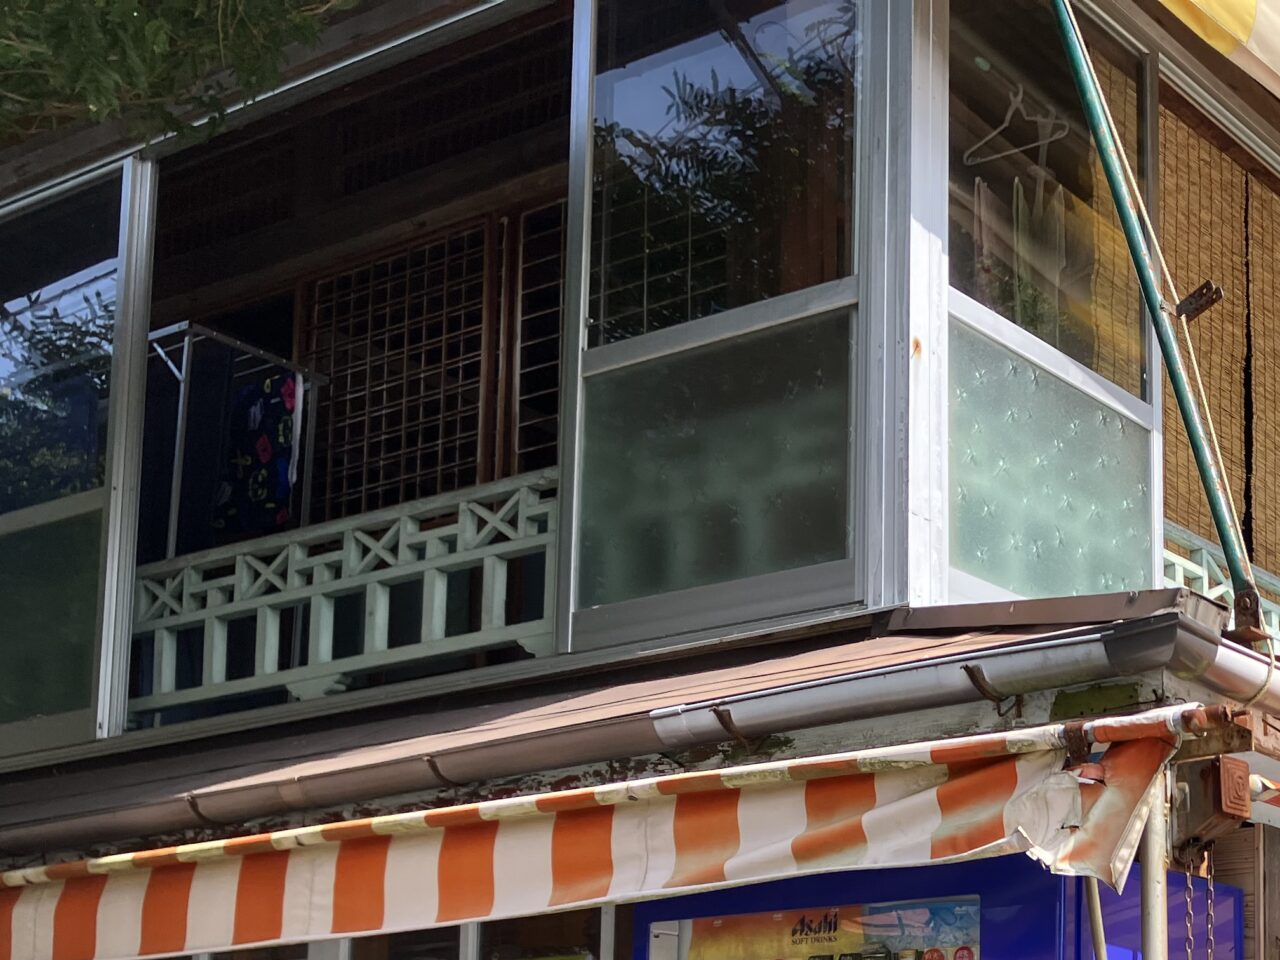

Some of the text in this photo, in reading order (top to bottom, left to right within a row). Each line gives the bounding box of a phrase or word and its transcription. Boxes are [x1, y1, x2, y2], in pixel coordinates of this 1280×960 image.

[791, 912, 838, 936] Asahi
[791, 935, 838, 945] SOFT DRINKS
